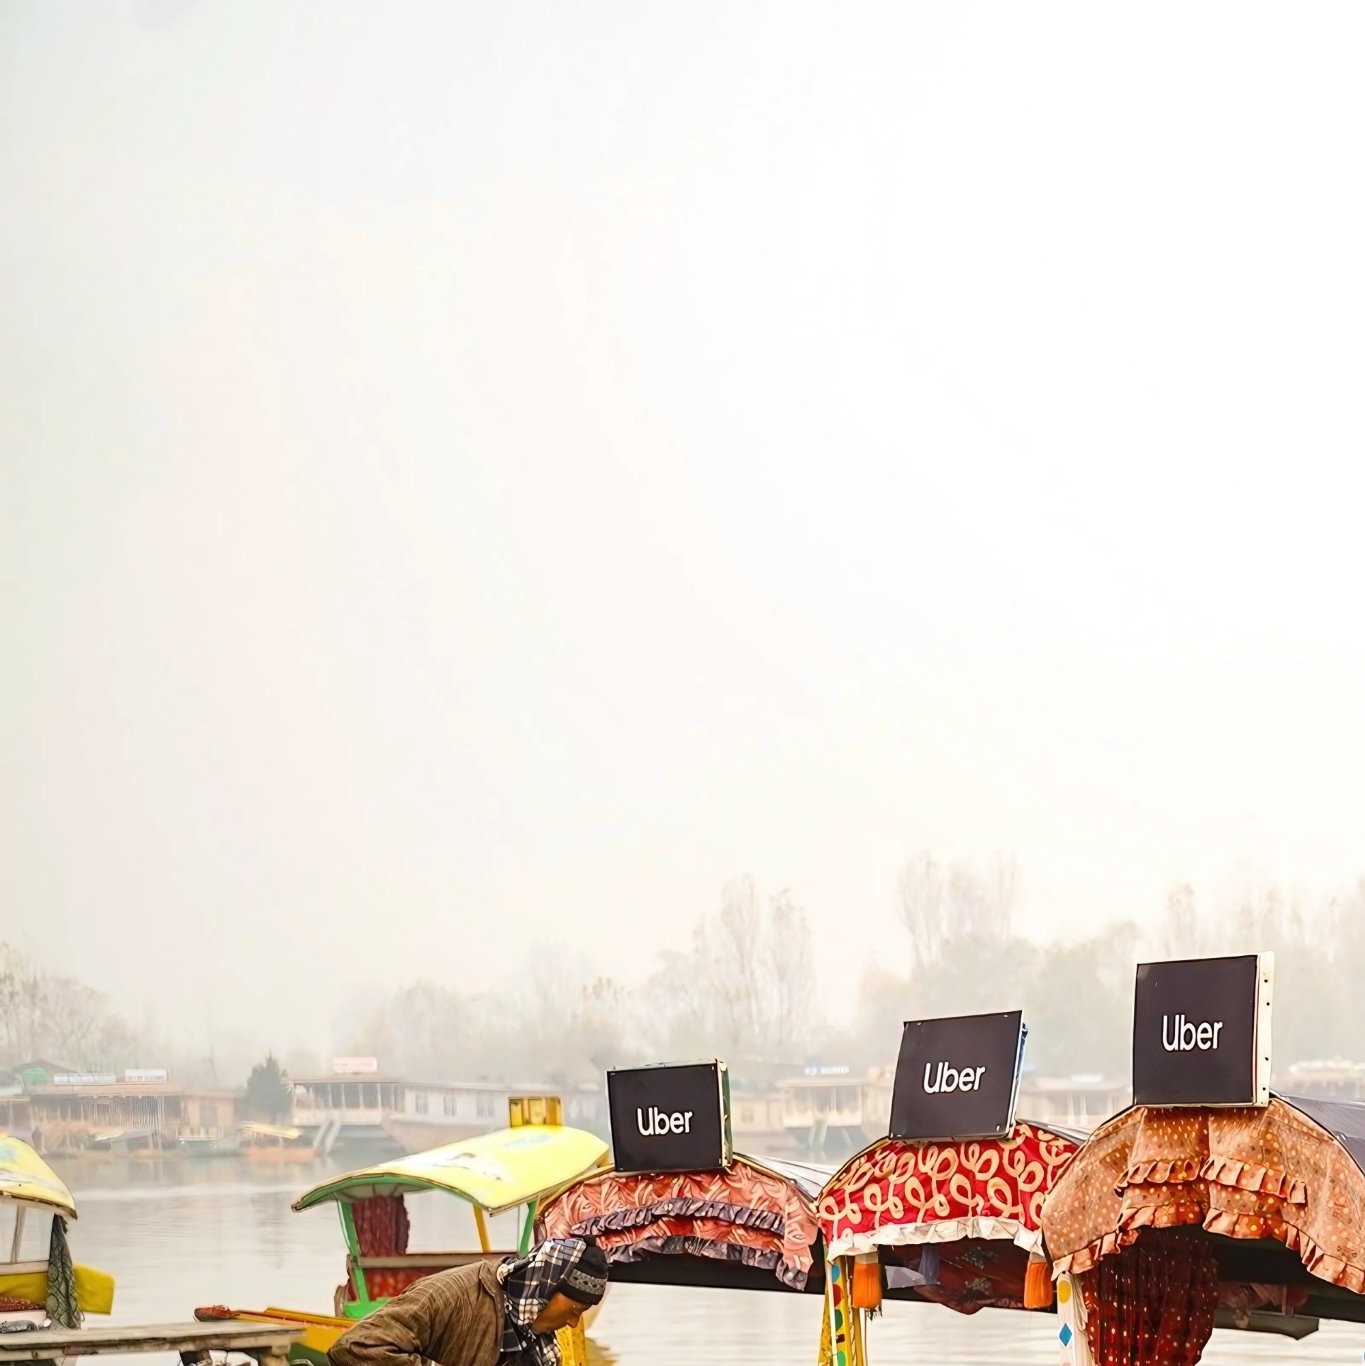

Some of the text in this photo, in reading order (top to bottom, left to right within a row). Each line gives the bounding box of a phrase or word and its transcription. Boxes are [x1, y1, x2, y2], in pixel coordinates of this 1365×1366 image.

[1162, 1014, 1223, 1051] Uber
[923, 1061, 986, 1094] Uber
[637, 1106, 693, 1136] Uber
